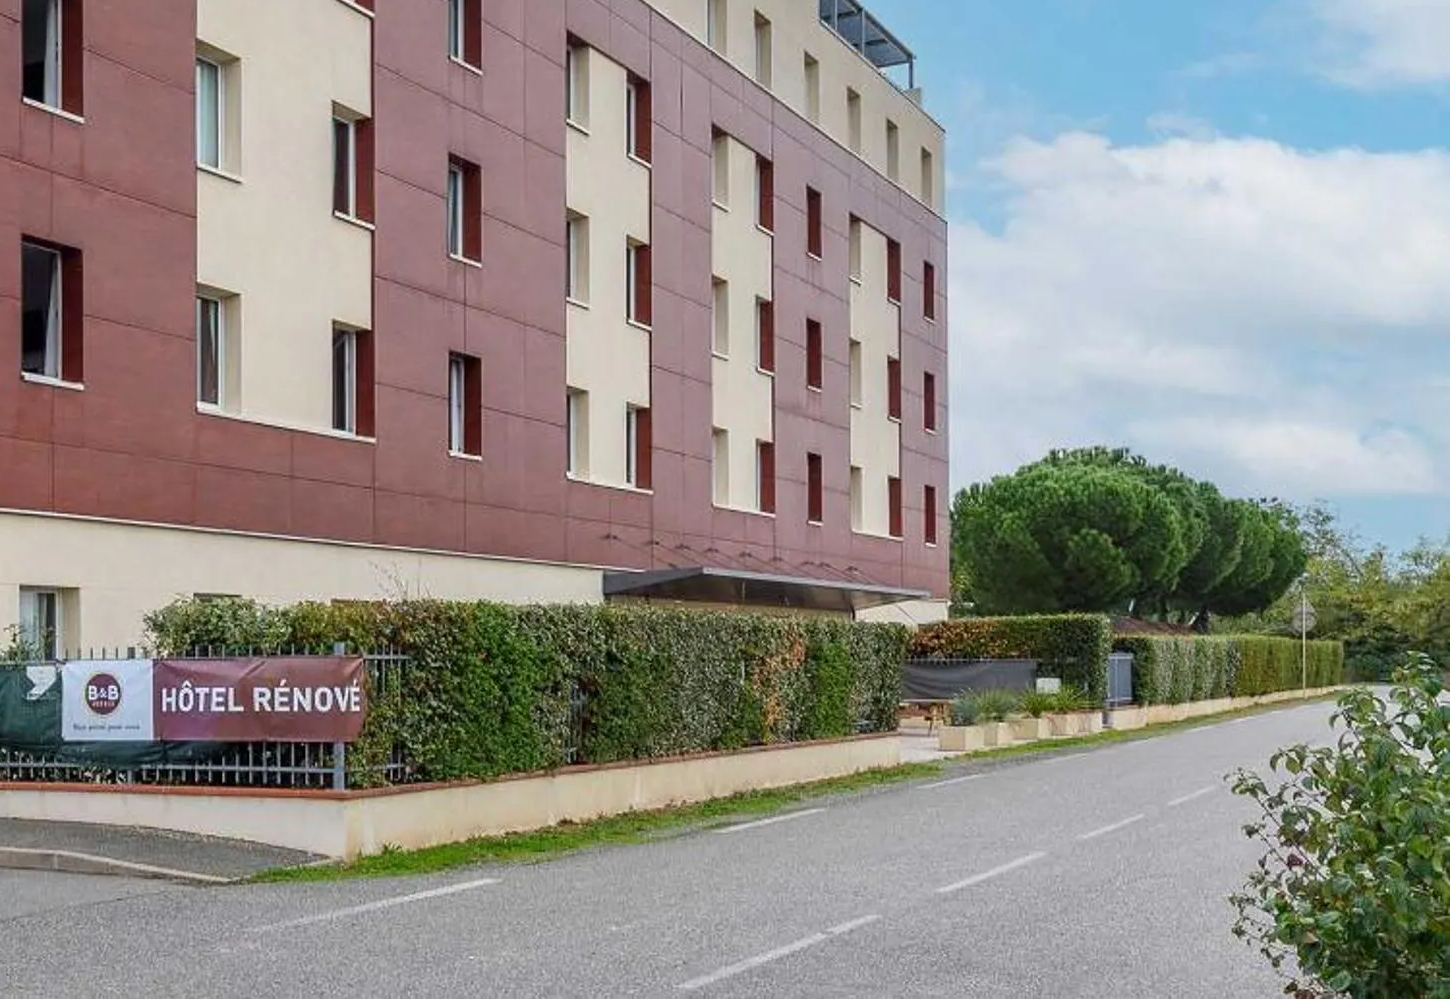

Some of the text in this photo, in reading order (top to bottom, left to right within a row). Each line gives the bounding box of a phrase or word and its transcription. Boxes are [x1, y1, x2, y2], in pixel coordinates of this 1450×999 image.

[88, 685, 119, 700] B&B
[161, 679, 361, 712] HÔTEL RÉNOVÉ
